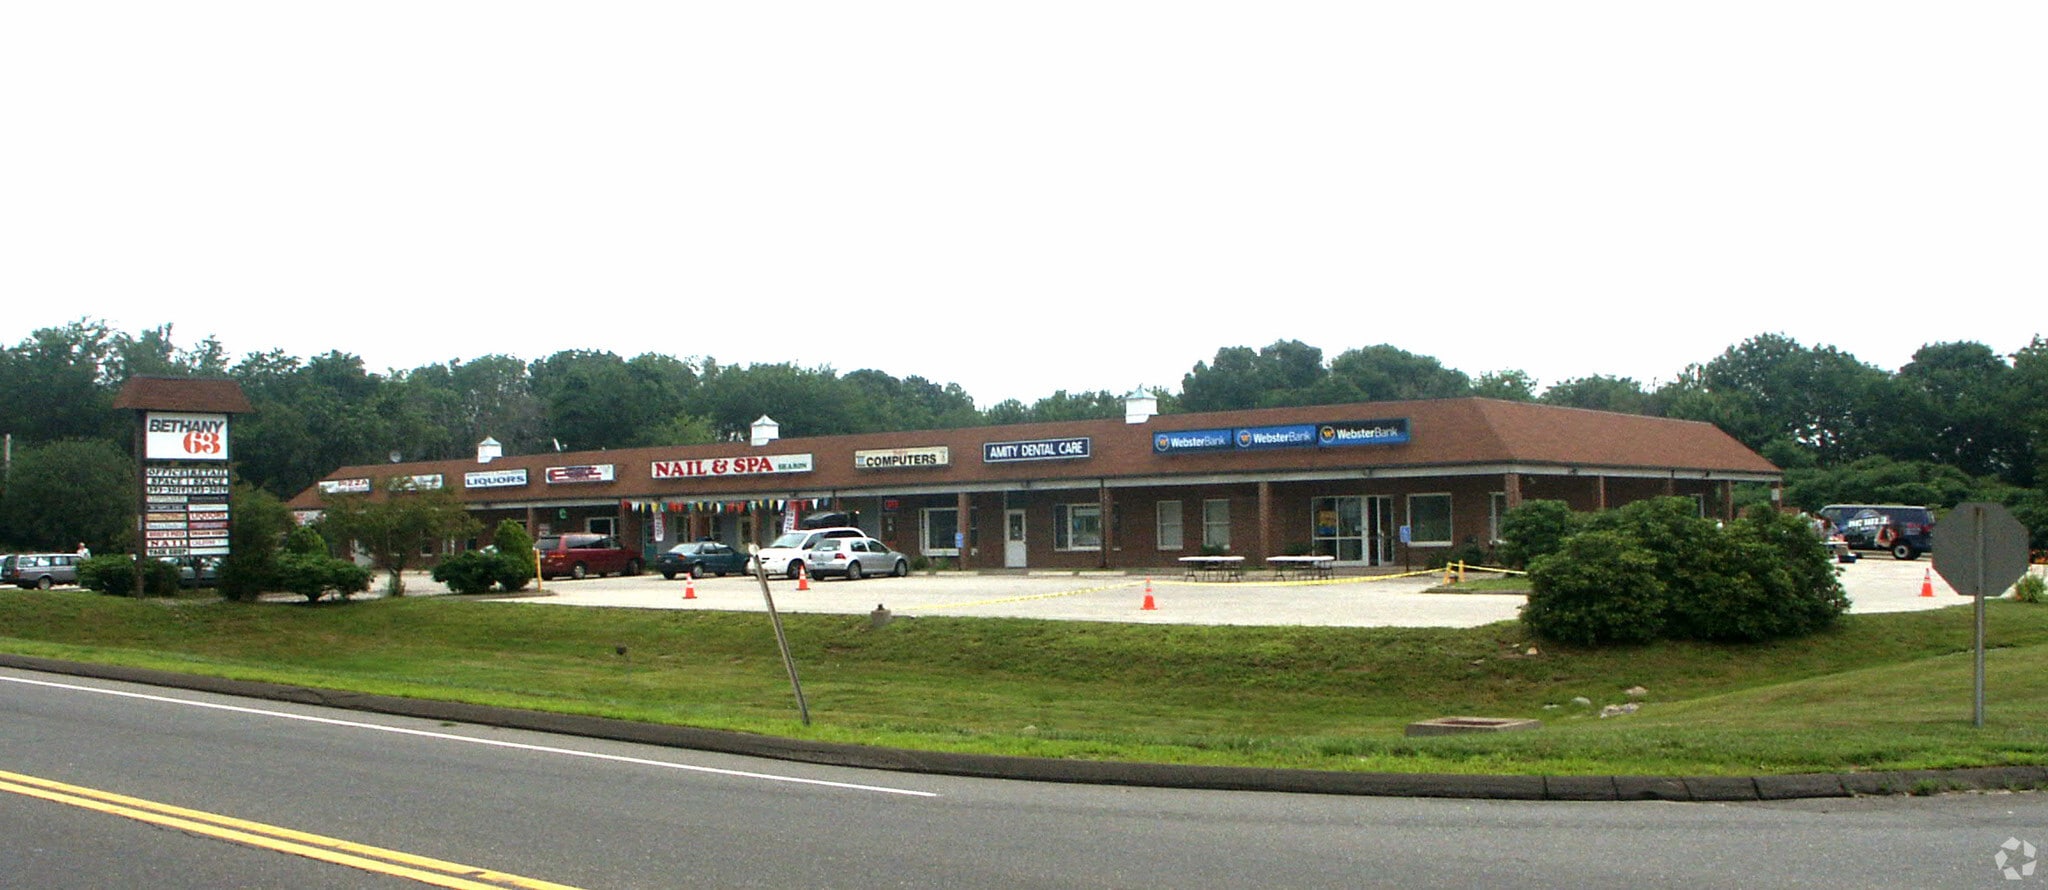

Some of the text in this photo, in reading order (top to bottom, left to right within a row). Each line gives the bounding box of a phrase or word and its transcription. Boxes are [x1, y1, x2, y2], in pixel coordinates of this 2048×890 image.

[149, 419, 224, 434] BETHANY
[1336, 426, 1398, 439] WebsterBank
[183, 431, 221, 454] 63
[1170, 435, 1225, 448] WebsterBank
[1253, 430, 1311, 443] WebsterBank
[990, 441, 1083, 458] AMITY DENTAL CARE
[866, 453, 937, 467] COMPUTERS
[655, 461, 707, 477] NAIL
[712, 459, 728, 474] &
[733, 457, 774, 473] SPA
[151, 477, 182, 485] SPACE
[466, 475, 525, 487] LIQUORS
[192, 511, 226, 520] LIQUORS
[151, 539, 187, 548] NAIL
